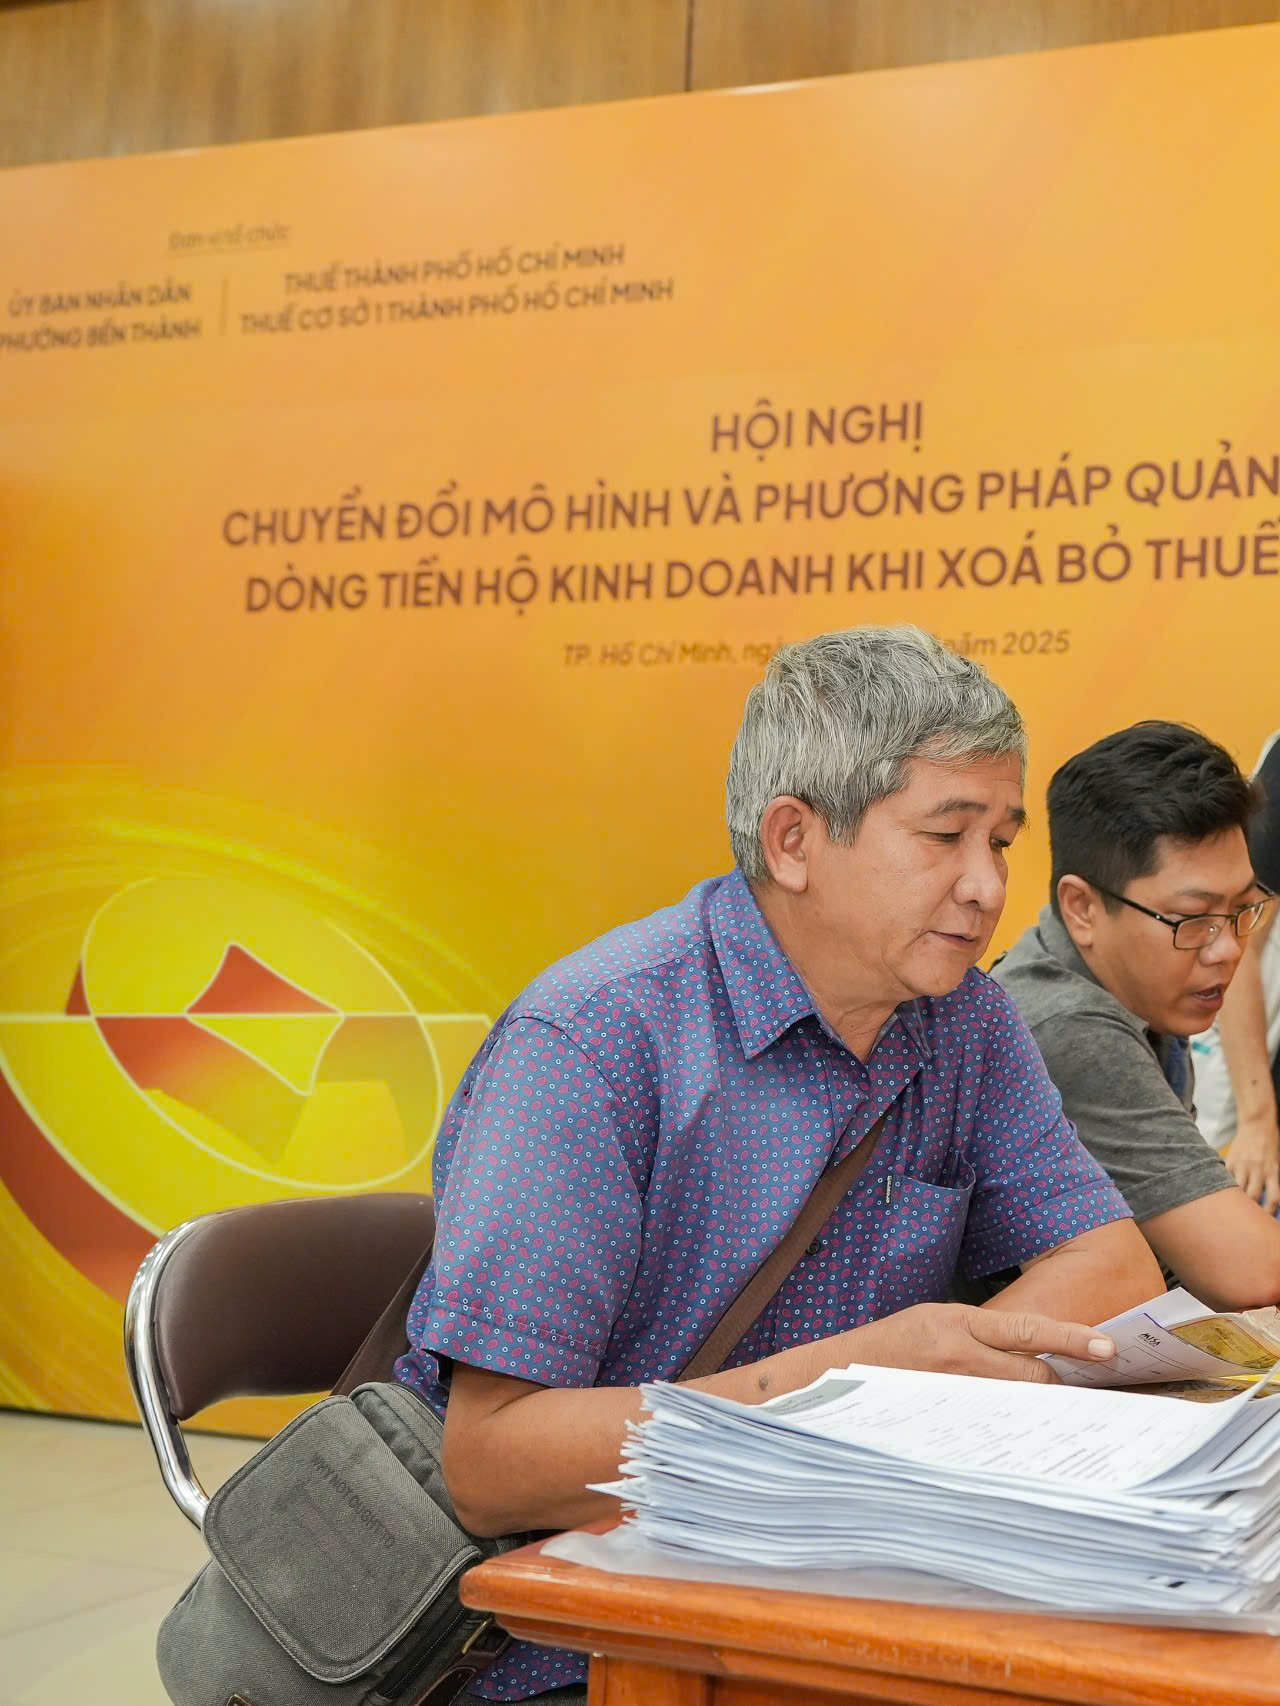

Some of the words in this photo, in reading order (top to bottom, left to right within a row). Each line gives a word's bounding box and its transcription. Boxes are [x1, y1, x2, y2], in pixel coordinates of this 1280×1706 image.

[284, 262, 339, 293] THUẾ
[343, 258, 417, 288] THÀNH
[422, 249, 472, 280] PHỐ
[517, 243, 559, 274] CHÍ
[562, 243, 625, 268] MINH
[39, 294, 81, 315] BAN
[131, 315, 202, 343] THÀNH
[241, 303, 294, 333] THUẾ
[300, 306, 333, 331] CƠ
[387, 292, 464, 321] THÀNH
[468, 285, 518, 316] PHỐ
[564, 278, 606, 309] CHÍ
[611, 280, 673, 304] MINH
[712, 399, 793, 461] HỘI
[807, 401, 922, 453] NGHỊ
[223, 485, 386, 547] CHUYỂN
[396, 480, 472, 539] ĐỔI
[483, 483, 555, 535] MÔ
[566, 480, 670, 531] HÌNH
[683, 472, 741, 525] VÀ
[755, 472, 964, 522] PHƯƠNG
[978, 452, 1112, 511] PHÁP
[1125, 440, 1280, 507] QUẢN
[246, 564, 368, 613] DÒNG
[378, 556, 463, 608] TIỀN
[475, 555, 539, 616] HỘ
[550, 562, 653, 602] KINH
[665, 554, 834, 599] DOANH
[848, 550, 924, 592] KHI
[937, 530, 1043, 589] XOÁ
[1057, 524, 1131, 584] BỎ
[1002, 629, 1070, 656] 2025
[1141, 1332, 1160, 1345] MISA
